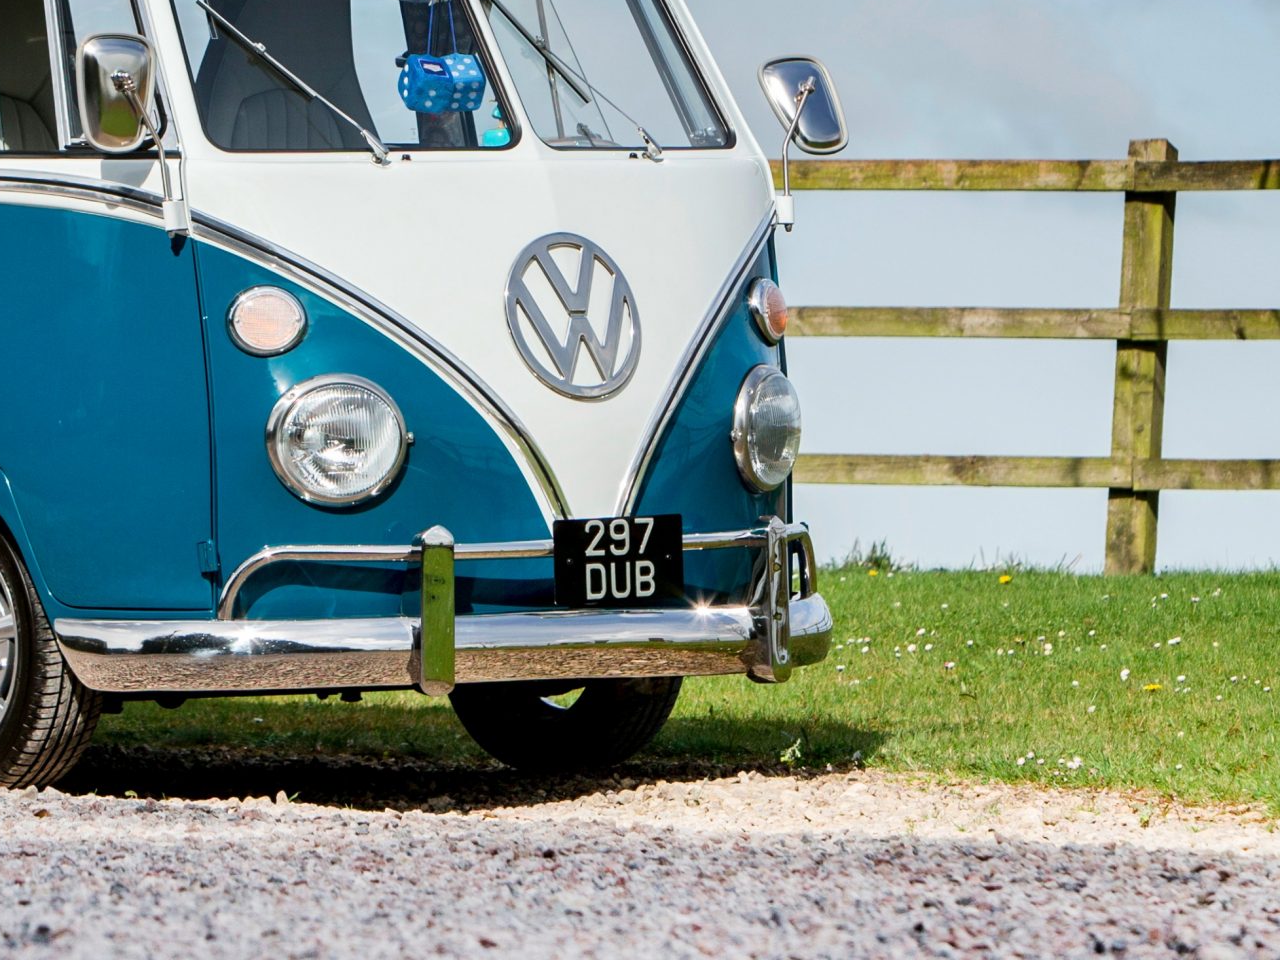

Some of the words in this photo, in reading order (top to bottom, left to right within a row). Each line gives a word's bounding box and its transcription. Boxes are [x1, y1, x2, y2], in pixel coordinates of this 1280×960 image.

[508, 236, 638, 396] VW
[584, 517, 655, 557] 297
[585, 560, 656, 601] DUB
